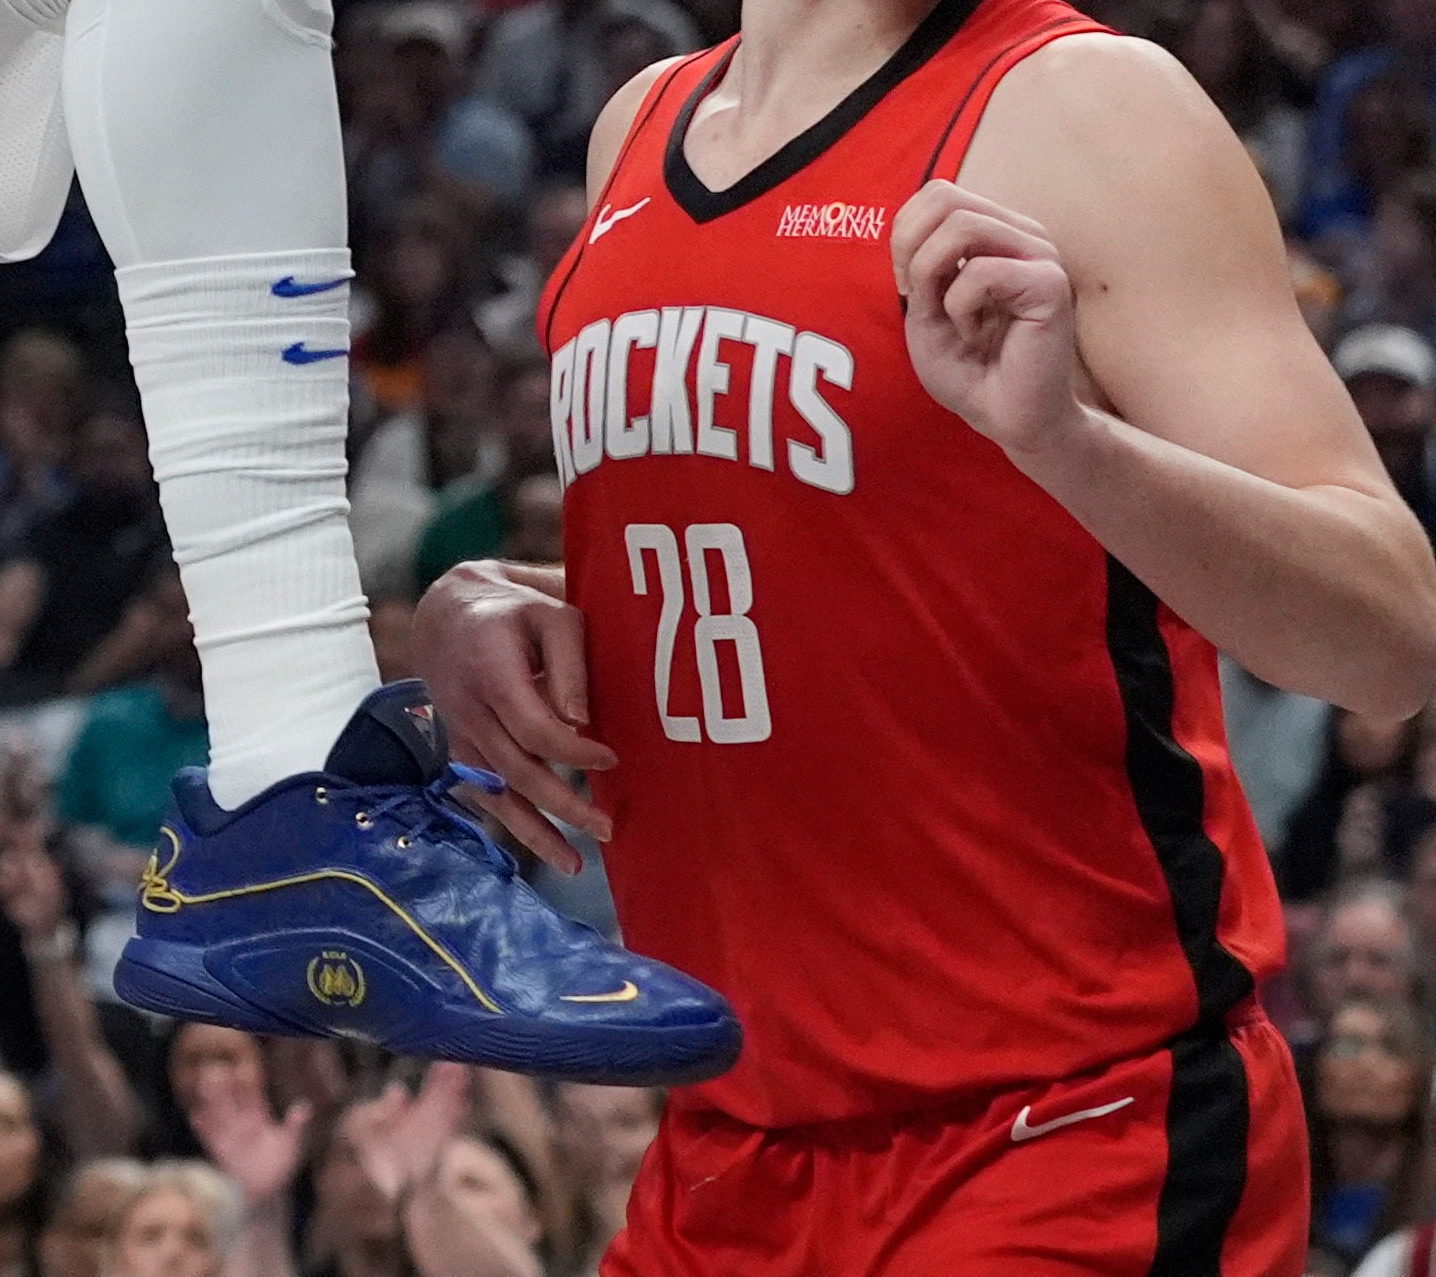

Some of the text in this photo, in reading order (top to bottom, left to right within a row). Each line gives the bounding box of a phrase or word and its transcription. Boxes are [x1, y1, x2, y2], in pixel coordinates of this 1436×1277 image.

[776, 220, 884, 240] HERMANN
[783, 202, 886, 224] MEMORIAL
[550, 305, 854, 494] ROCKETS
[626, 522, 772, 744] 28
